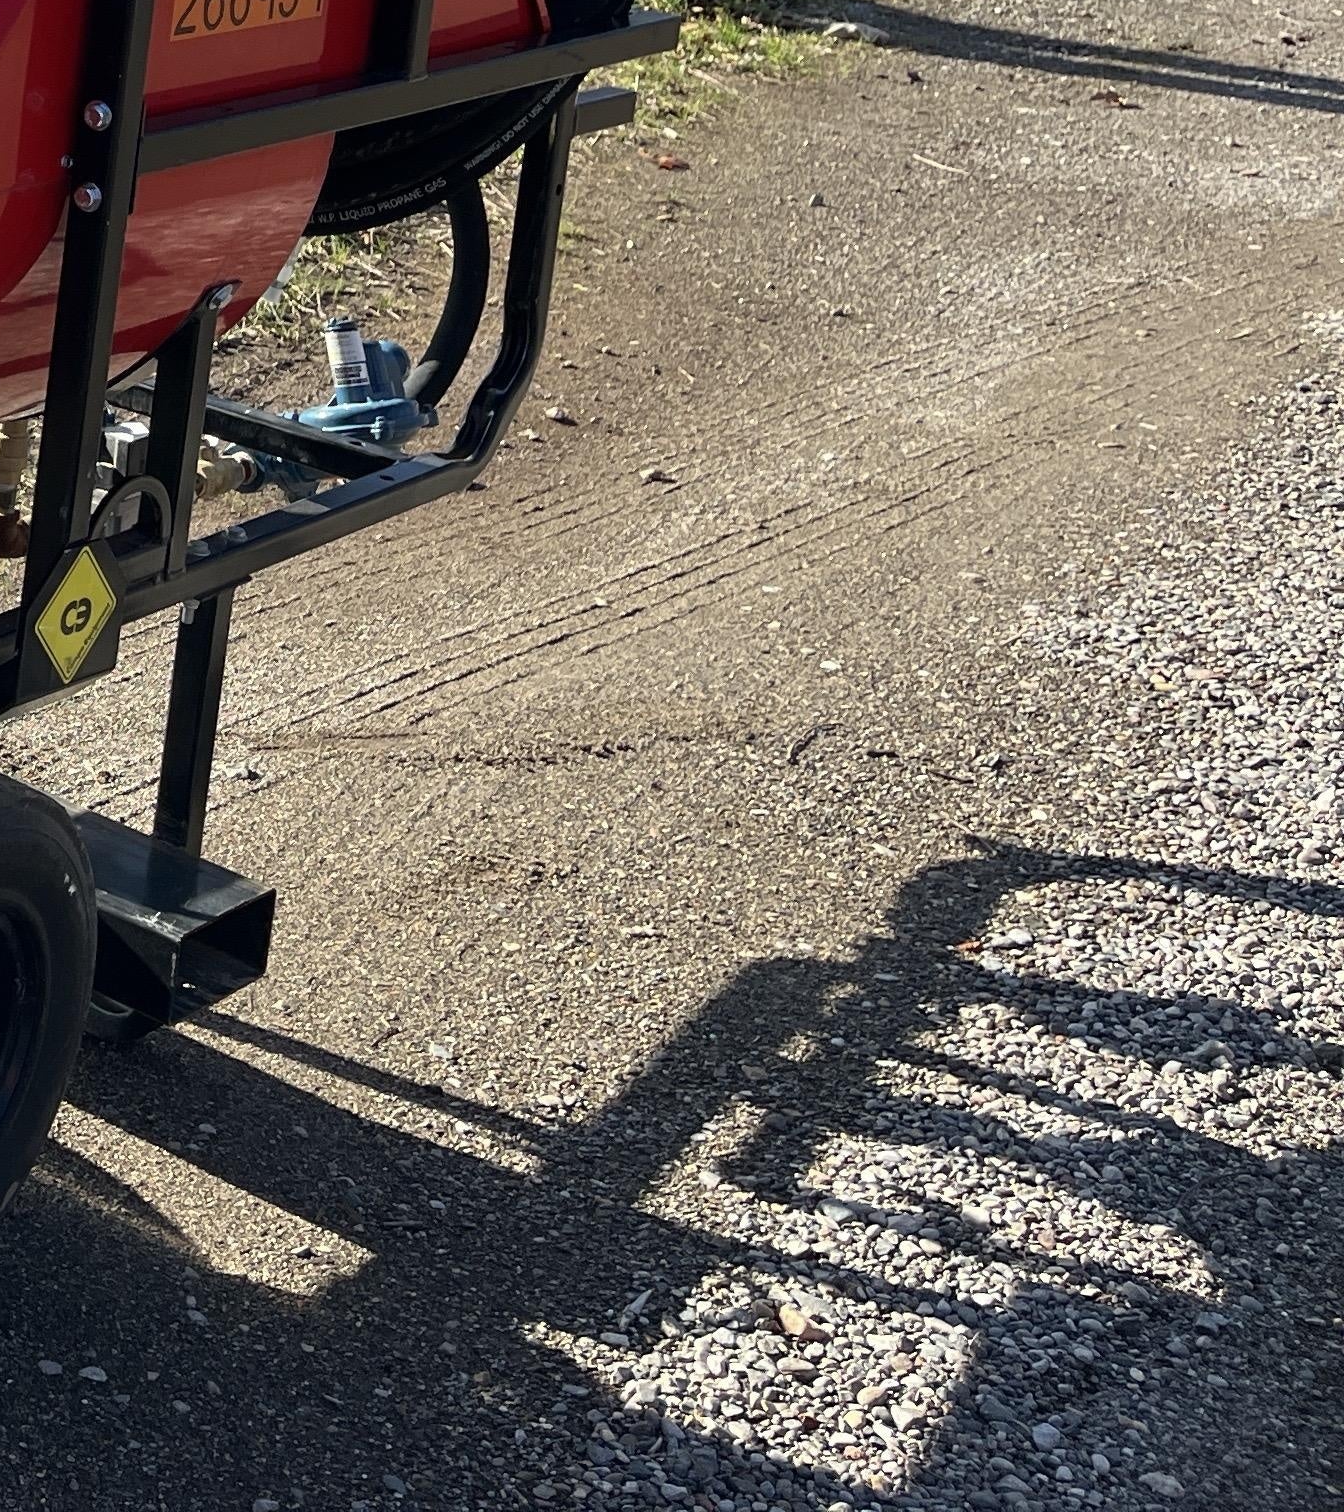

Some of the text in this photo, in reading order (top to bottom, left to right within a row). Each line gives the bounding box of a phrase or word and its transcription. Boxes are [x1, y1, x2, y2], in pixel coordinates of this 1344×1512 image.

[339, 204, 376, 223] LIQUID
[377, 187, 423, 213] PROPANE
[424, 176, 448, 194] GAS
